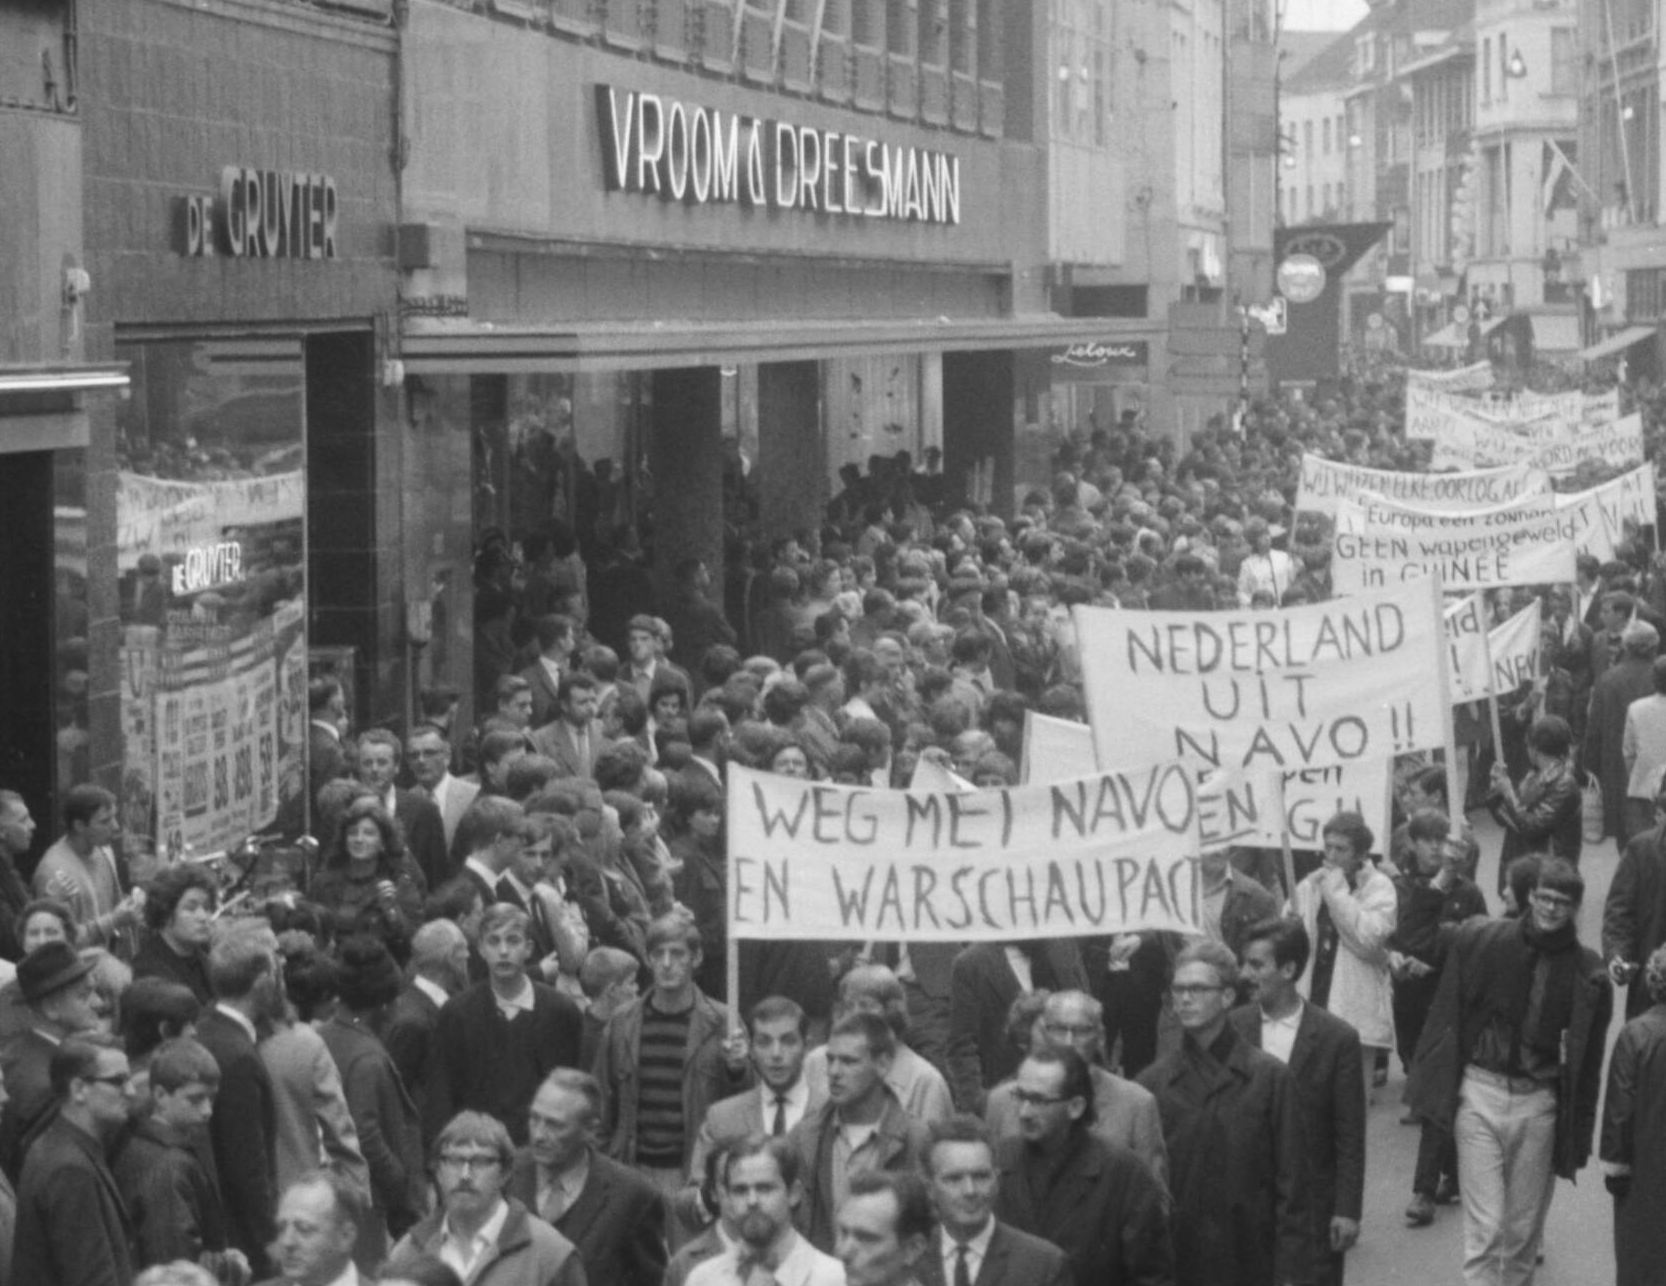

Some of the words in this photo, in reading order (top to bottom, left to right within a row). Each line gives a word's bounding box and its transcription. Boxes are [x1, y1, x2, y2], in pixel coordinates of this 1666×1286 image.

[609, 88, 738, 202] VROOM
[775, 121, 961, 224] DREESMANN
[187, 194, 214, 256] DE
[222, 165, 339, 259] GRUYTER
[1433, 476, 1500, 503] OORLOG
[1336, 532, 1409, 561] GEEN
[1419, 517, 1575, 557] wapengeweld
[1361, 562, 1385, 588] in
[1126, 602, 1405, 675] NEDERLAND
[1174, 715, 1369, 770] NAVO
[751, 779, 879, 846] WEG
[1050, 763, 1194, 841] NAVO
[733, 855, 791, 925] EN
